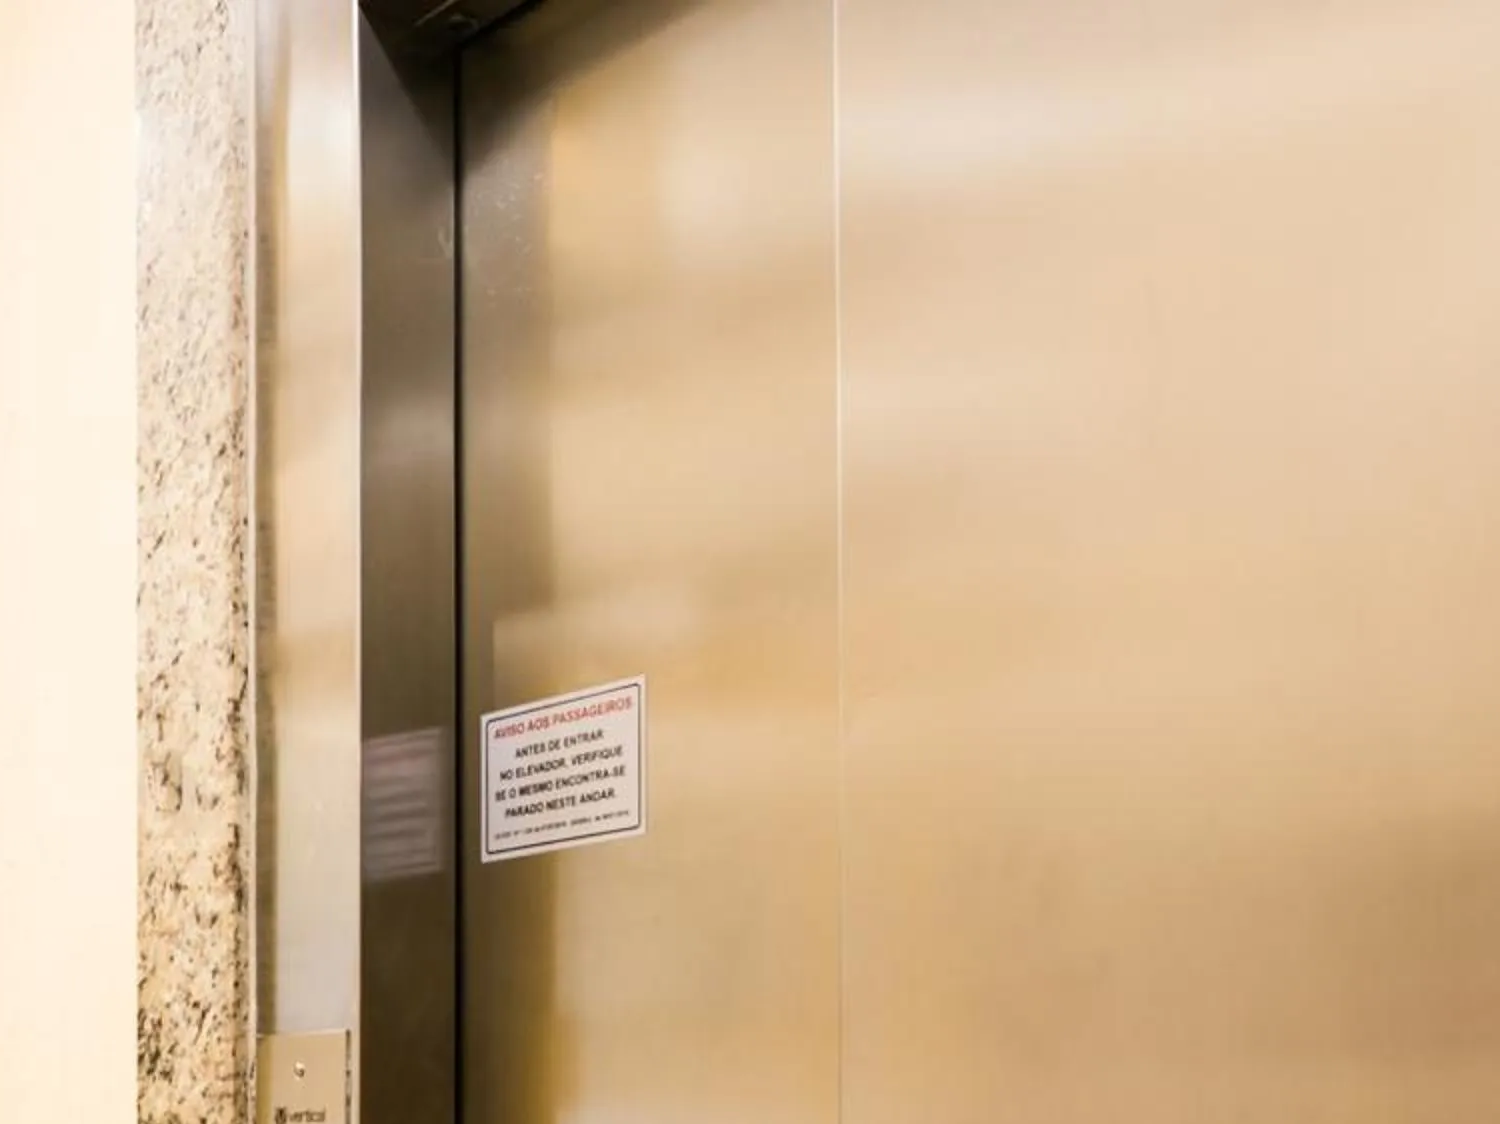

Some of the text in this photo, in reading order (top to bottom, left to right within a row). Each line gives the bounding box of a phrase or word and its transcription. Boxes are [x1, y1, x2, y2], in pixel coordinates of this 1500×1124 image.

[494, 696, 632, 738] AVISO AOS PASSAGEIROS
[515, 729, 604, 758] ANTES DE ENTRAR
[500, 769, 514, 780] NO
[572, 745, 622, 766] VERIFIQUE
[495, 764, 626, 801] SE O MESMO ENCONTRA-SE
[505, 801, 544, 818] PARADO
[546, 796, 575, 810] NESTE
